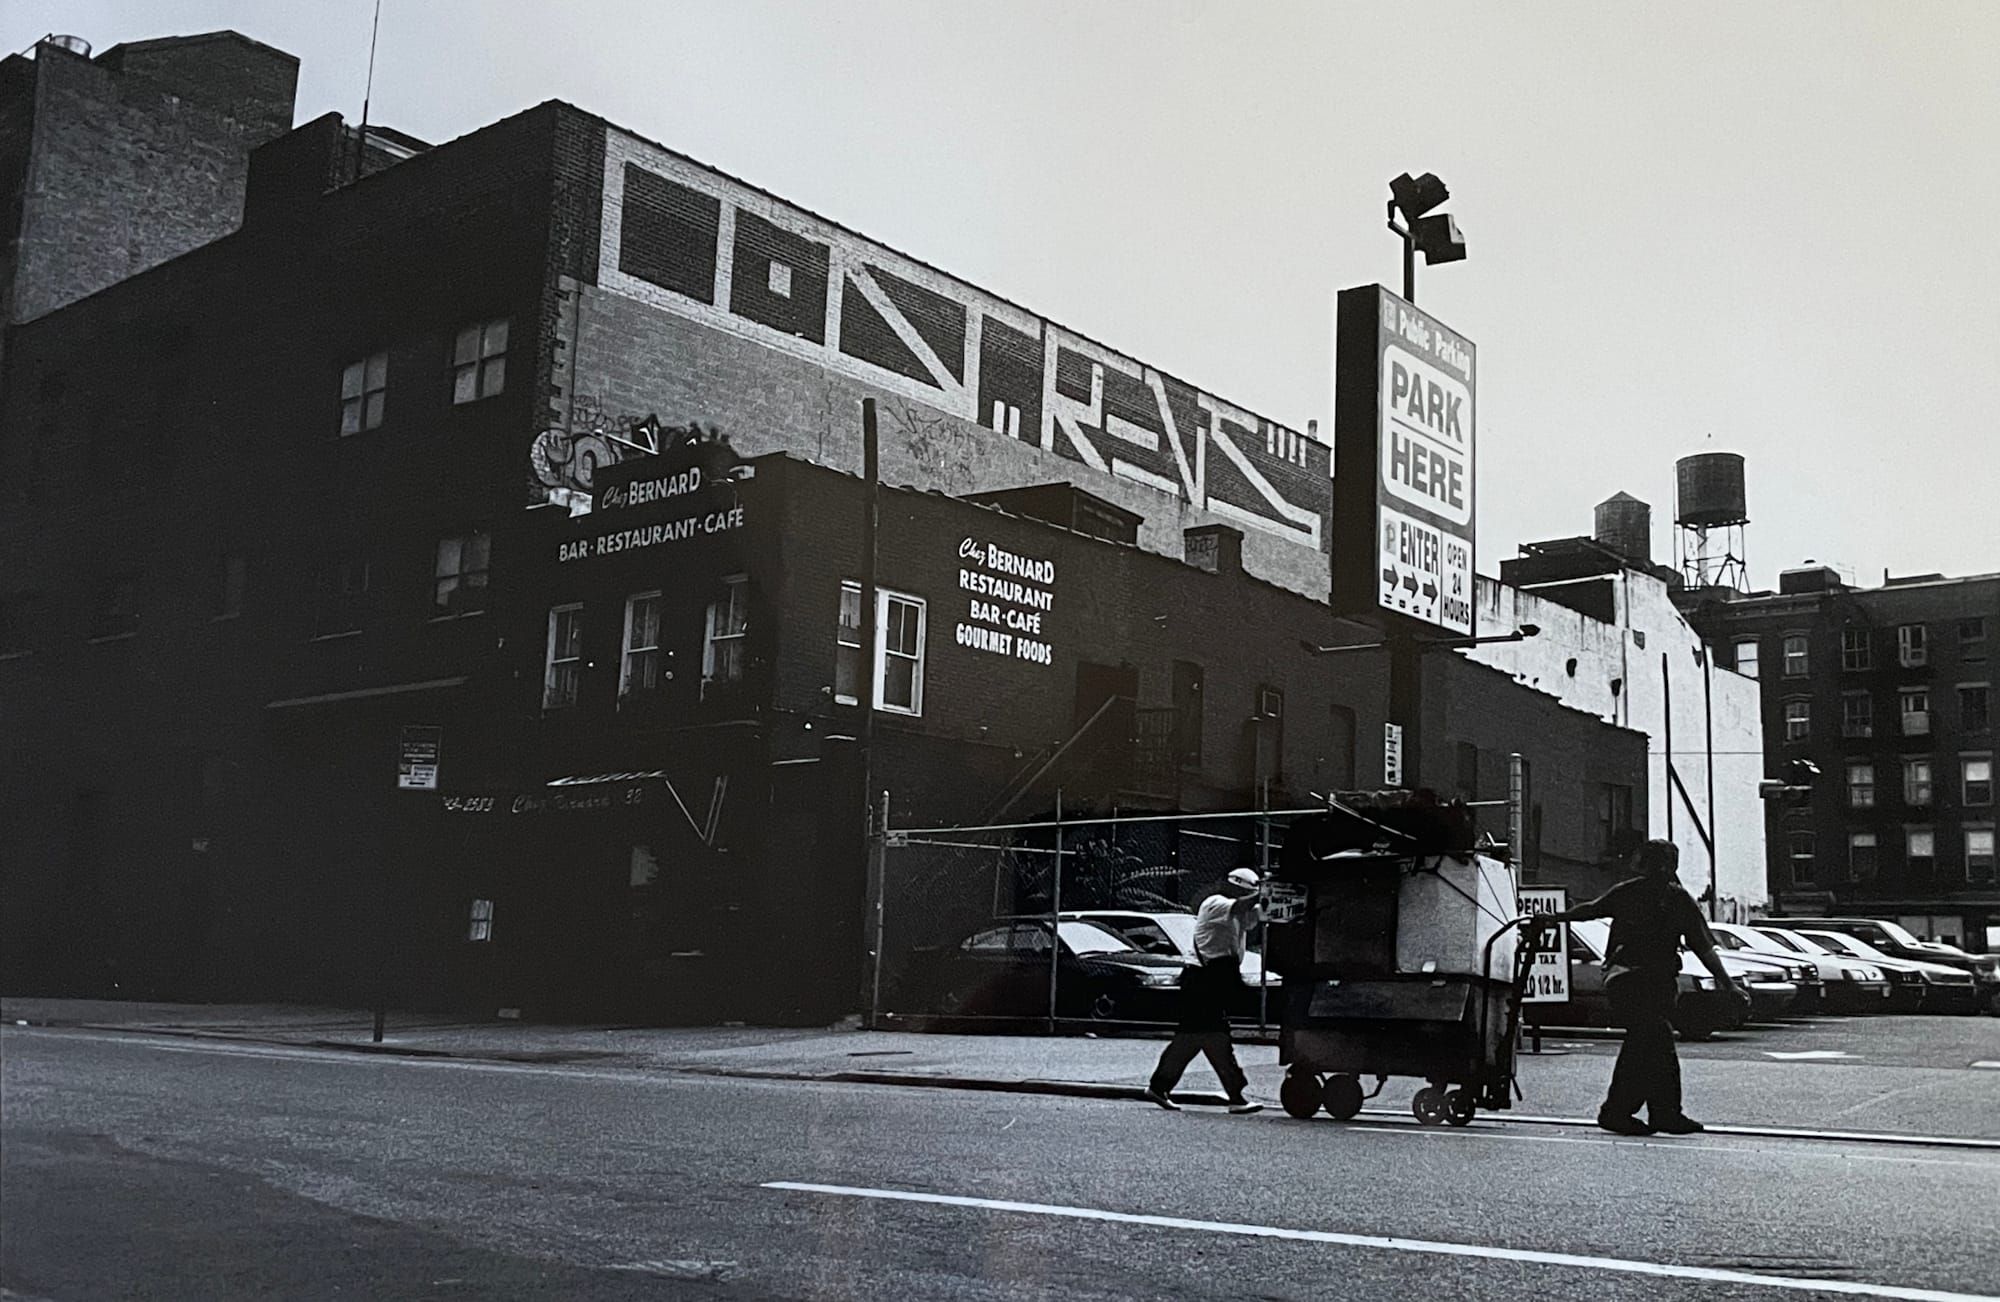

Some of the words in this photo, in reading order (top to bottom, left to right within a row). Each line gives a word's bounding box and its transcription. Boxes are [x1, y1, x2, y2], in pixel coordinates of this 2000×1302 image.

[1391, 360, 1463, 444] PARK
[601, 486, 629, 509] Chez
[629, 466, 701, 505] BERNARD
[1391, 431, 1463, 510] HERE
[597, 517, 698, 555] RESTAURANT
[1400, 520, 1439, 577] ENTER
[1447, 542, 1467, 571] OPEN
[959, 537, 986, 566] Chez
[987, 543, 1055, 585] BERNARD
[959, 568, 1054, 611] RESTAURANT
[1452, 573, 1462, 596] 24
[1443, 595, 1470, 626] HOURS
[956, 622, 1013, 656] GOURMET
[1016, 636, 1052, 665] FOODS
[1517, 897, 1557, 916] PECIAL
[1538, 954, 1557, 965] TAX
